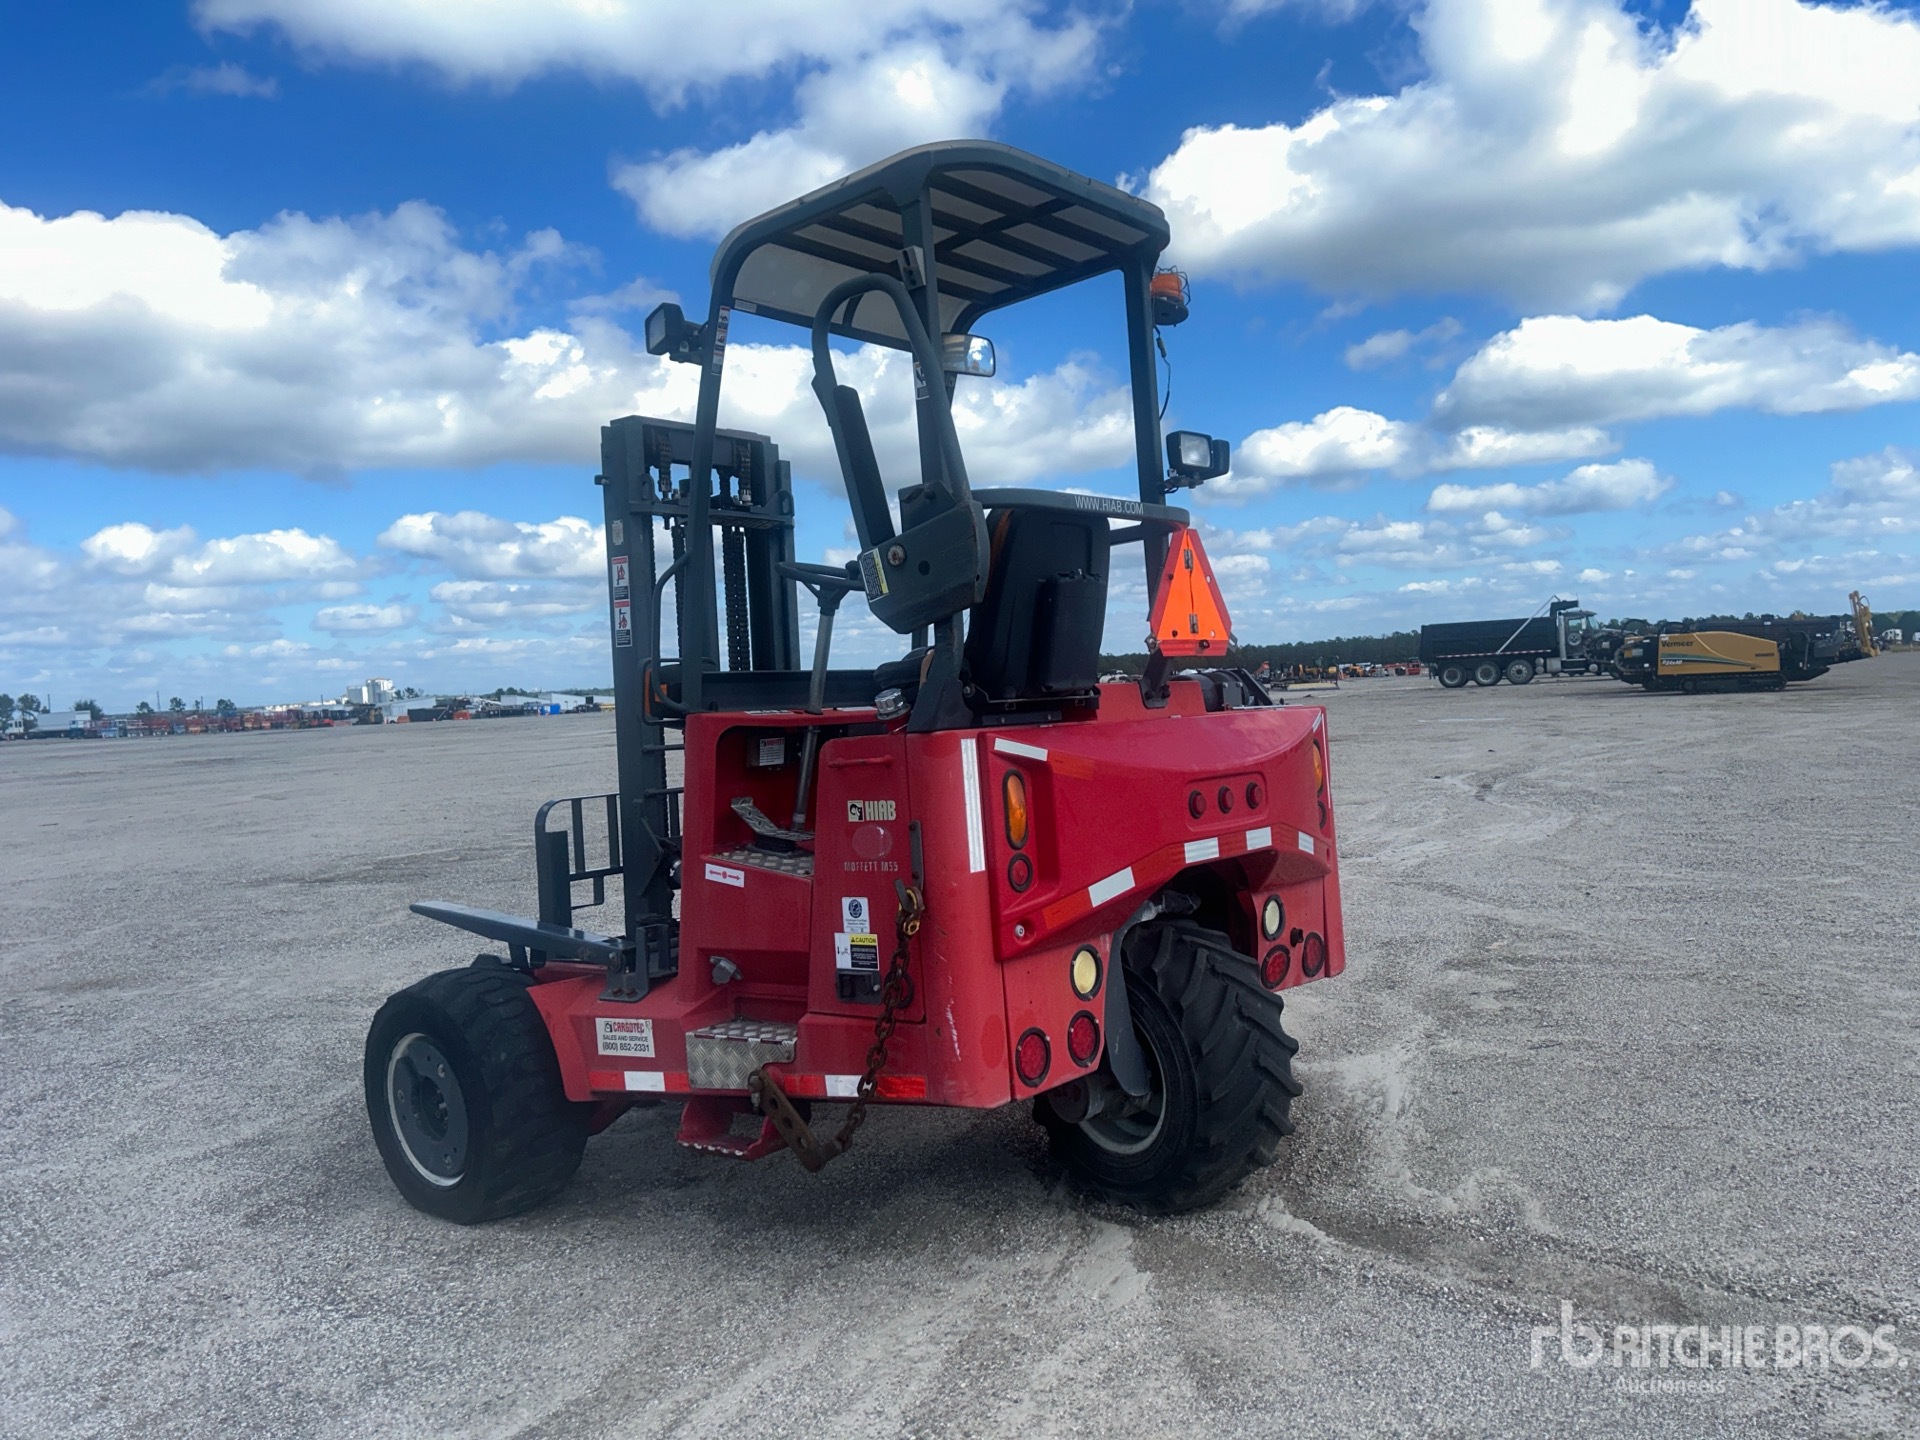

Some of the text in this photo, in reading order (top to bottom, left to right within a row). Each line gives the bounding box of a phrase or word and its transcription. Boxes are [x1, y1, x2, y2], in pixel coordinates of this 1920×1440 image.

[1074, 495, 1144, 515] WWW.HIAB.COM
[1661, 640, 1694, 648] Vermeer
[865, 800, 897, 821] HIAB
[844, 861, 877, 872] MOFFETT
[855, 936, 877, 944] CAUTION
[613, 1021, 645, 1034] CARGOTEC
[602, 1041, 650, 1053] (800) 852-2331
